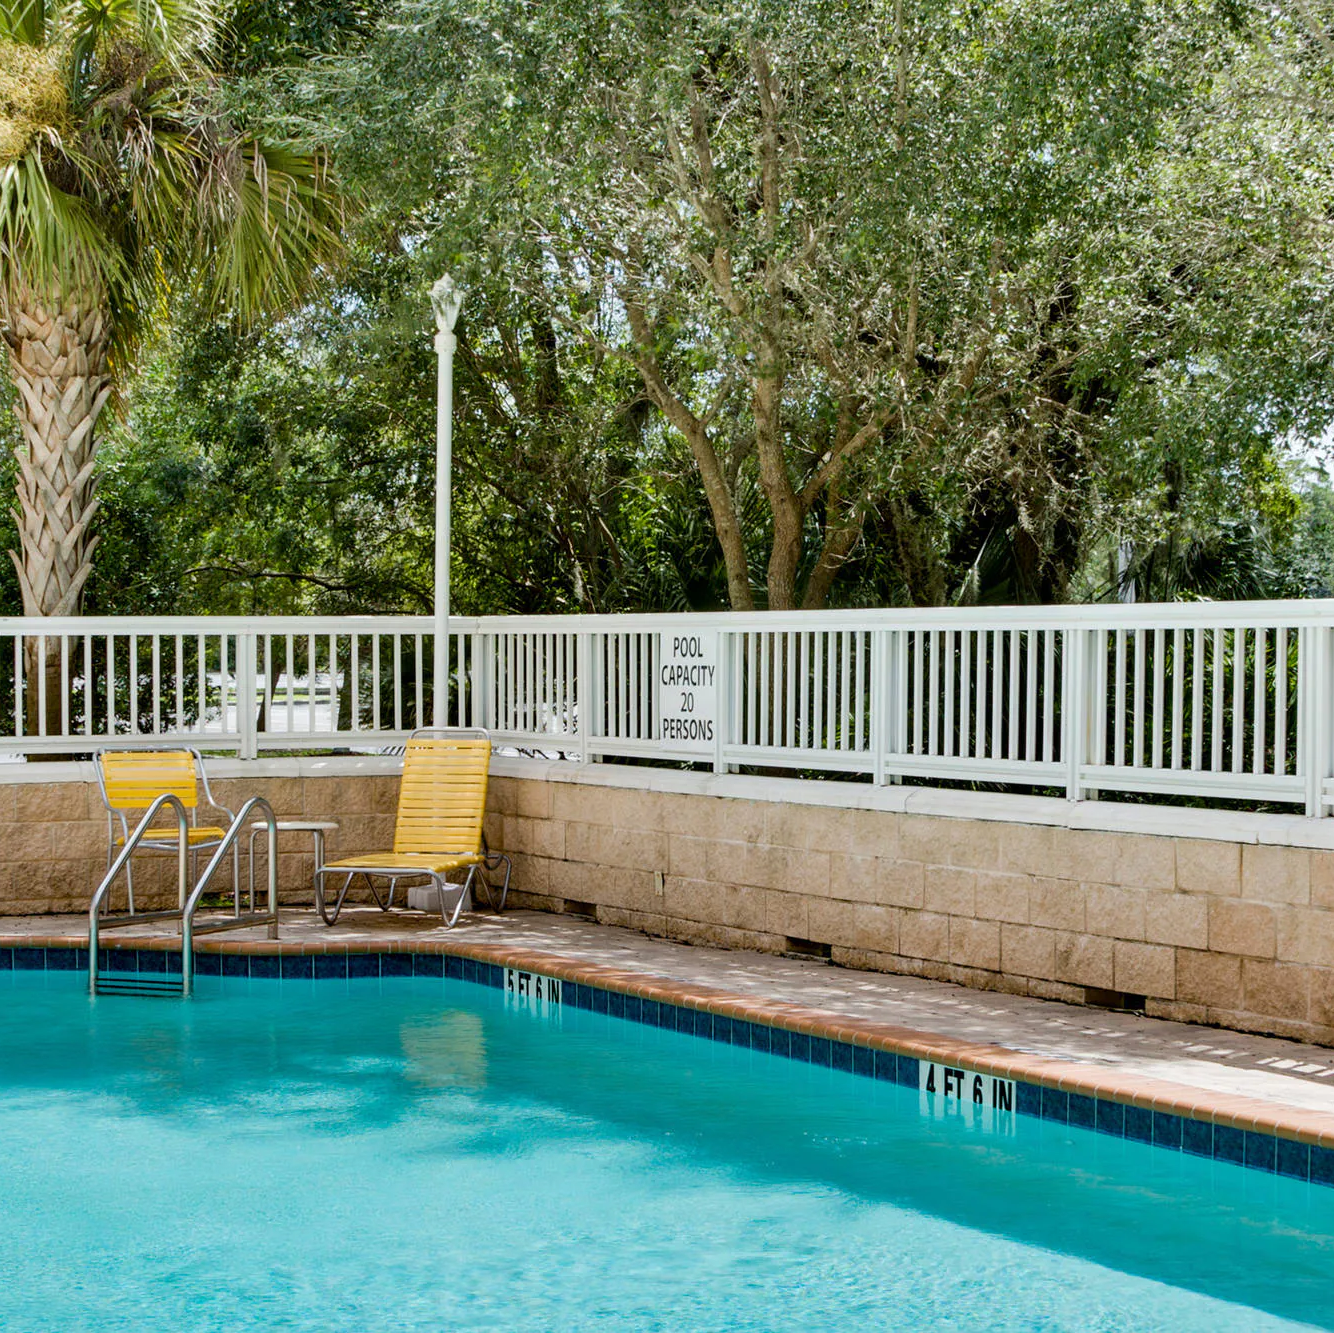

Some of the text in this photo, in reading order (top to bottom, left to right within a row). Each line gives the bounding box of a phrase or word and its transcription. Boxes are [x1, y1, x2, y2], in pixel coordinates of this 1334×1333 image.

[673, 637, 703, 657] POOL
[661, 665, 715, 687] CAPACITY
[680, 692, 694, 712] 20
[663, 718, 713, 741] PERSONS
[508, 969, 559, 1004] 5 FT 6 IN
[926, 1064, 1012, 1112] 4 FT 6 IN
